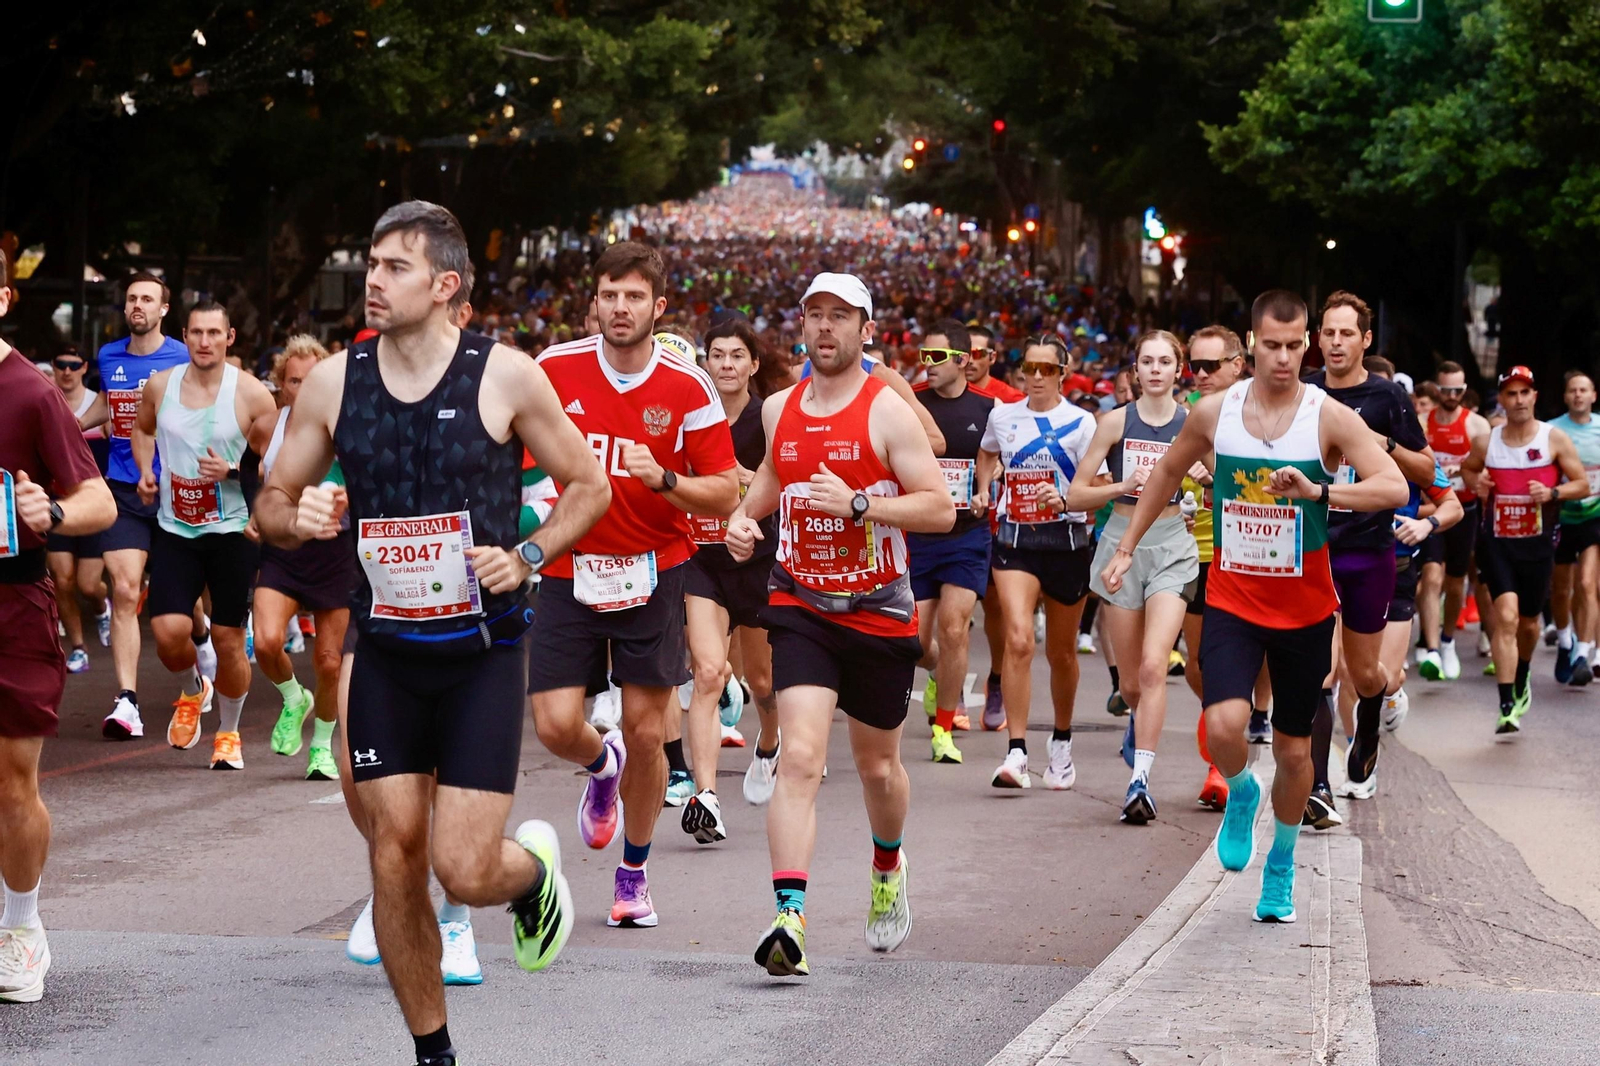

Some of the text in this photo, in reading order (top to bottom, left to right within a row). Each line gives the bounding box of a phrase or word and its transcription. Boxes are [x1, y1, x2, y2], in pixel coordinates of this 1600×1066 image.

[110, 374, 128, 382] ABEL
[117, 402, 138, 413] 335
[1141, 443, 1169, 453] GENER
[828, 450, 852, 461] MÁLAGA
[1016, 471, 1051, 481] GENERALI
[178, 487, 203, 500] 4633
[1015, 483, 1039, 495] 359
[1241, 505, 1289, 520] GENERALI
[385, 517, 453, 537] GENERALI
[805, 516, 845, 533] 2688
[1236, 520, 1282, 537] 15707
[461, 535, 471, 549] BOX
[377, 542, 443, 565] 23047
[810, 552, 830, 560] MÁLAGA
[389, 565, 435, 575] SOFÍA&ENZO
[585, 556, 635, 573] 17596
[468, 580, 477, 595] BOX
[394, 590, 420, 599] MÁLAGA
